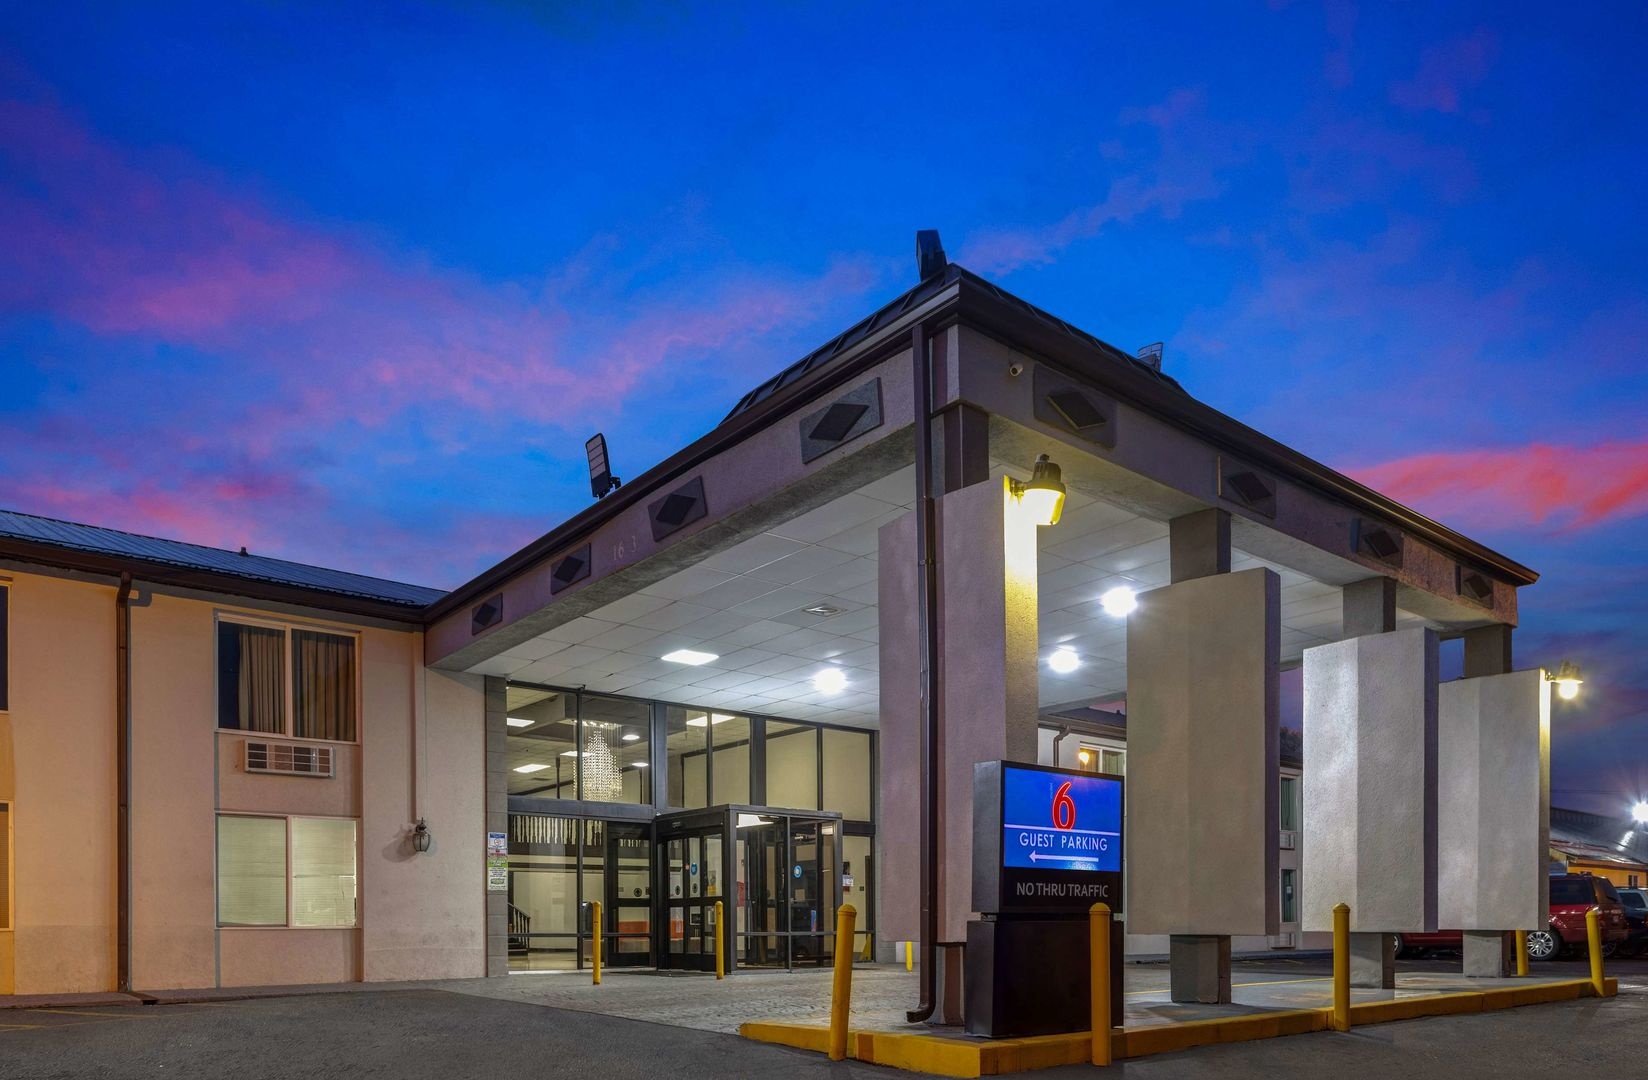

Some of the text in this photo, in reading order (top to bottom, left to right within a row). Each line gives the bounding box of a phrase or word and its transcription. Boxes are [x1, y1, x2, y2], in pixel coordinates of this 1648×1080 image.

[1052, 781, 1076, 830] 6
[1019, 832, 1108, 851] GUEST PARKING
[1016, 882, 1109, 897] NO THRU TRAFFIC
